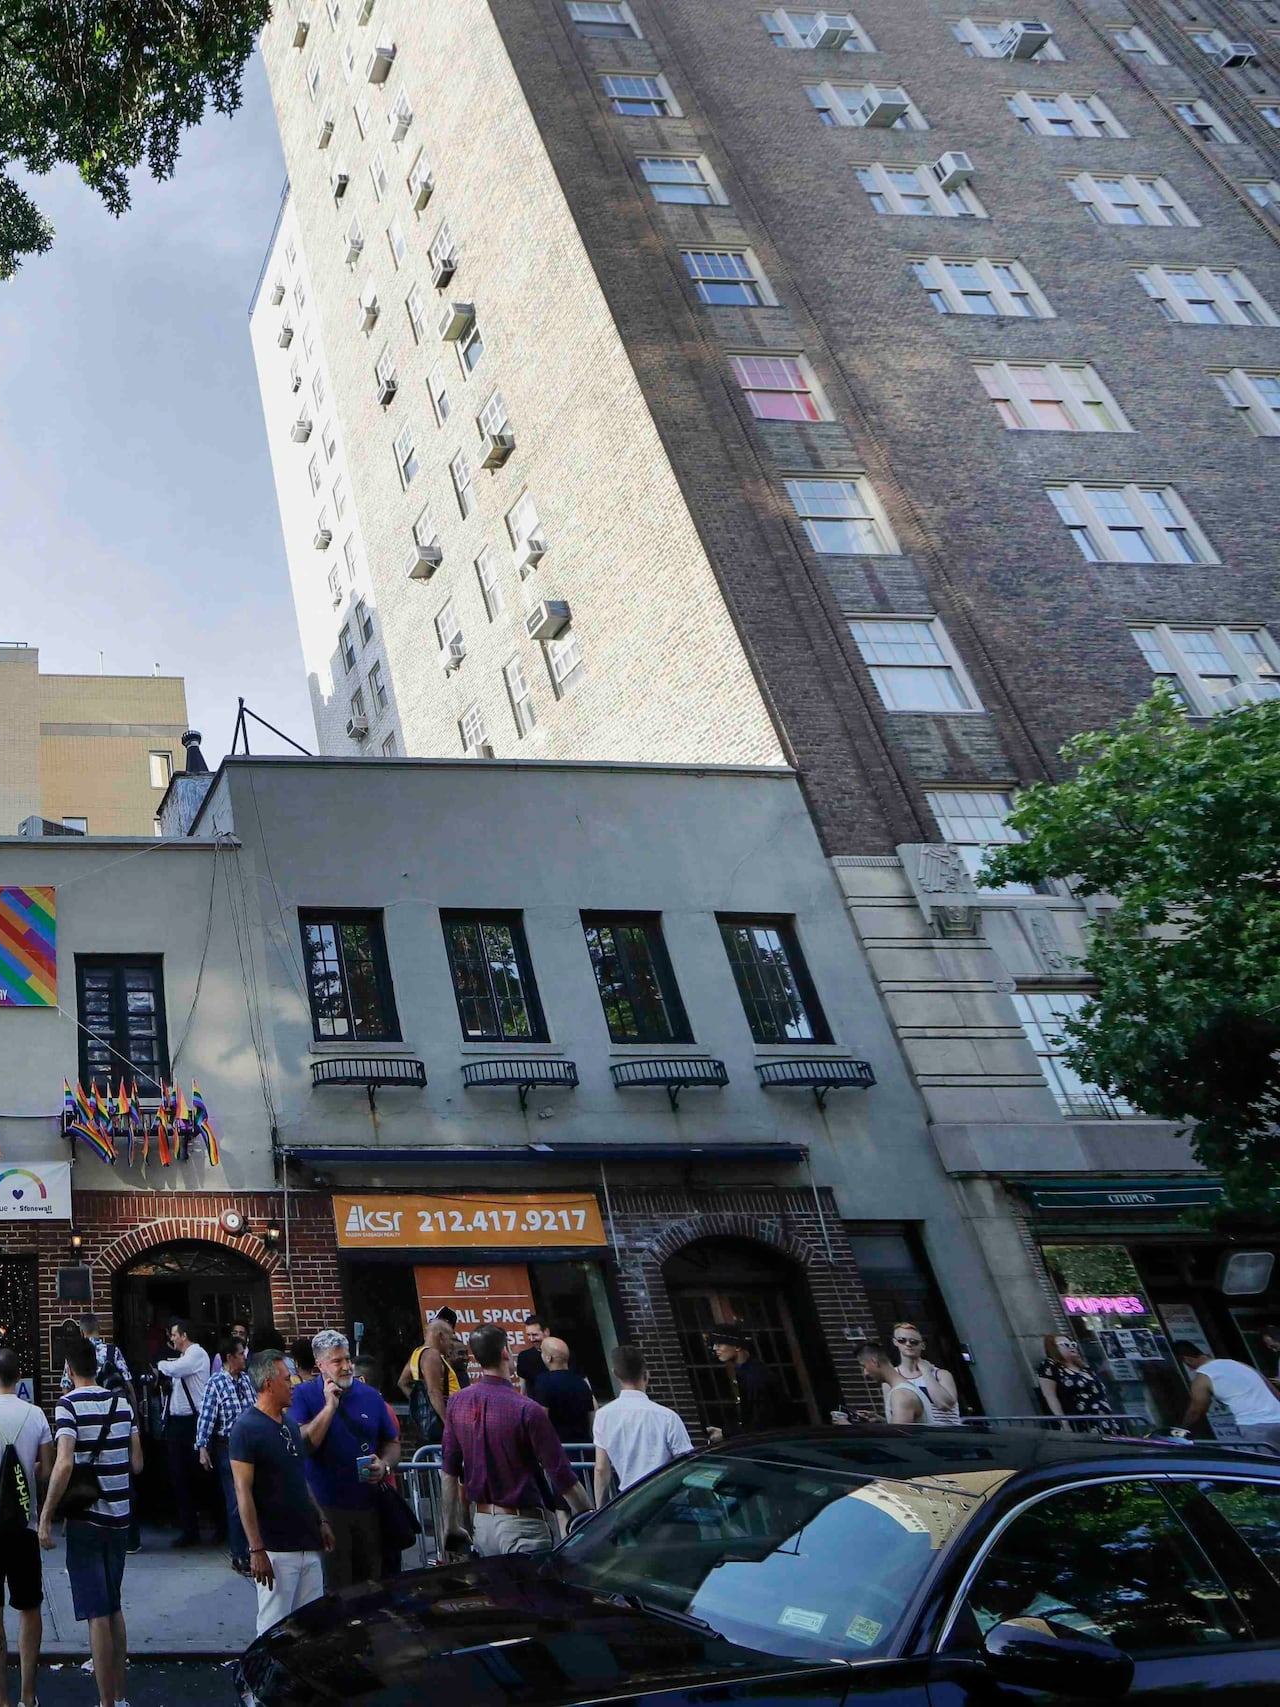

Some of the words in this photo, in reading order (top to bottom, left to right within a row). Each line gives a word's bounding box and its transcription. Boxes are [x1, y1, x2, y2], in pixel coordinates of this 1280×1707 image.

[19, 1204, 52, 1212] Stonewall
[419, 1209, 586, 1233] 212.417.9217
[1065, 1297, 1145, 1313] PUPPIES
[425, 1309, 481, 1324] RAIL
[482, 1309, 532, 1324] SPACE
[17, 1382, 30, 1399] A
